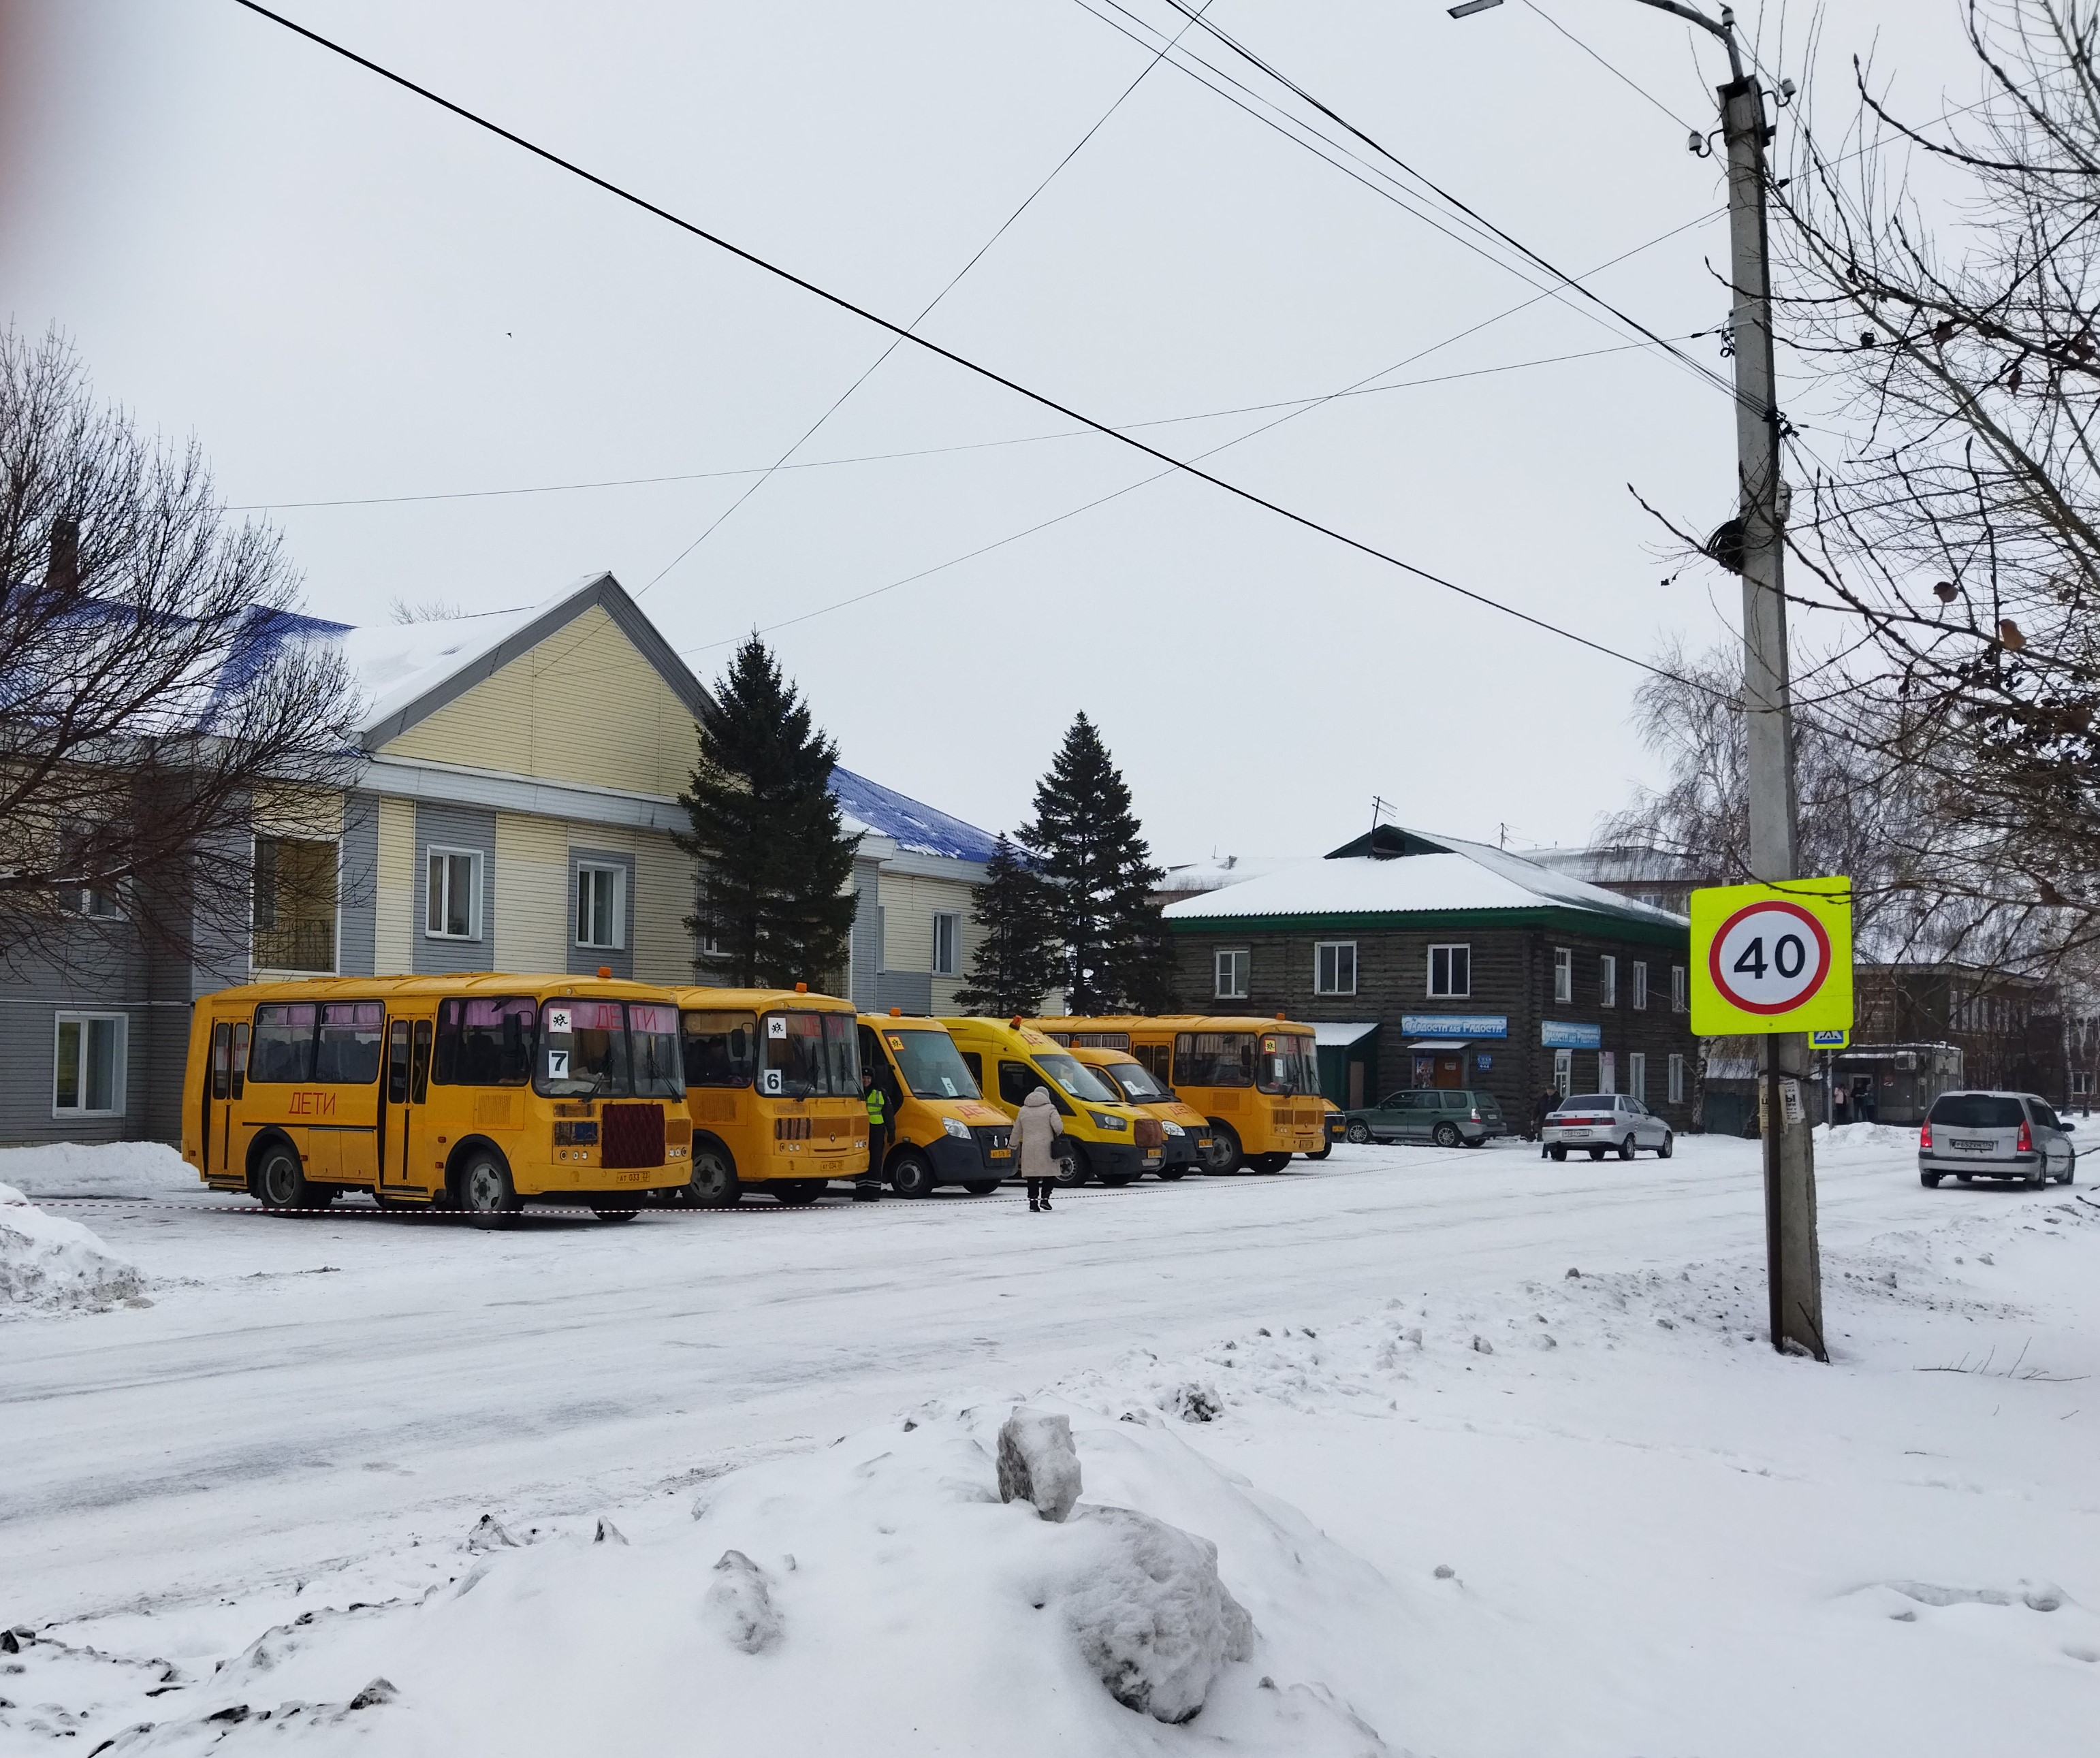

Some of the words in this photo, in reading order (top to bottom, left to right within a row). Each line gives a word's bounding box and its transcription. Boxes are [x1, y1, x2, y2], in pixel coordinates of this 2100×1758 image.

[1734, 933, 1806, 979] 40
[595, 1005, 656, 1030] ДЕТИ
[552, 1053, 567, 1071] 7
[767, 1074, 780, 1090] 6
[1128, 1084, 1136, 1092] 3
[289, 1092, 336, 1115] ДЕТИ
